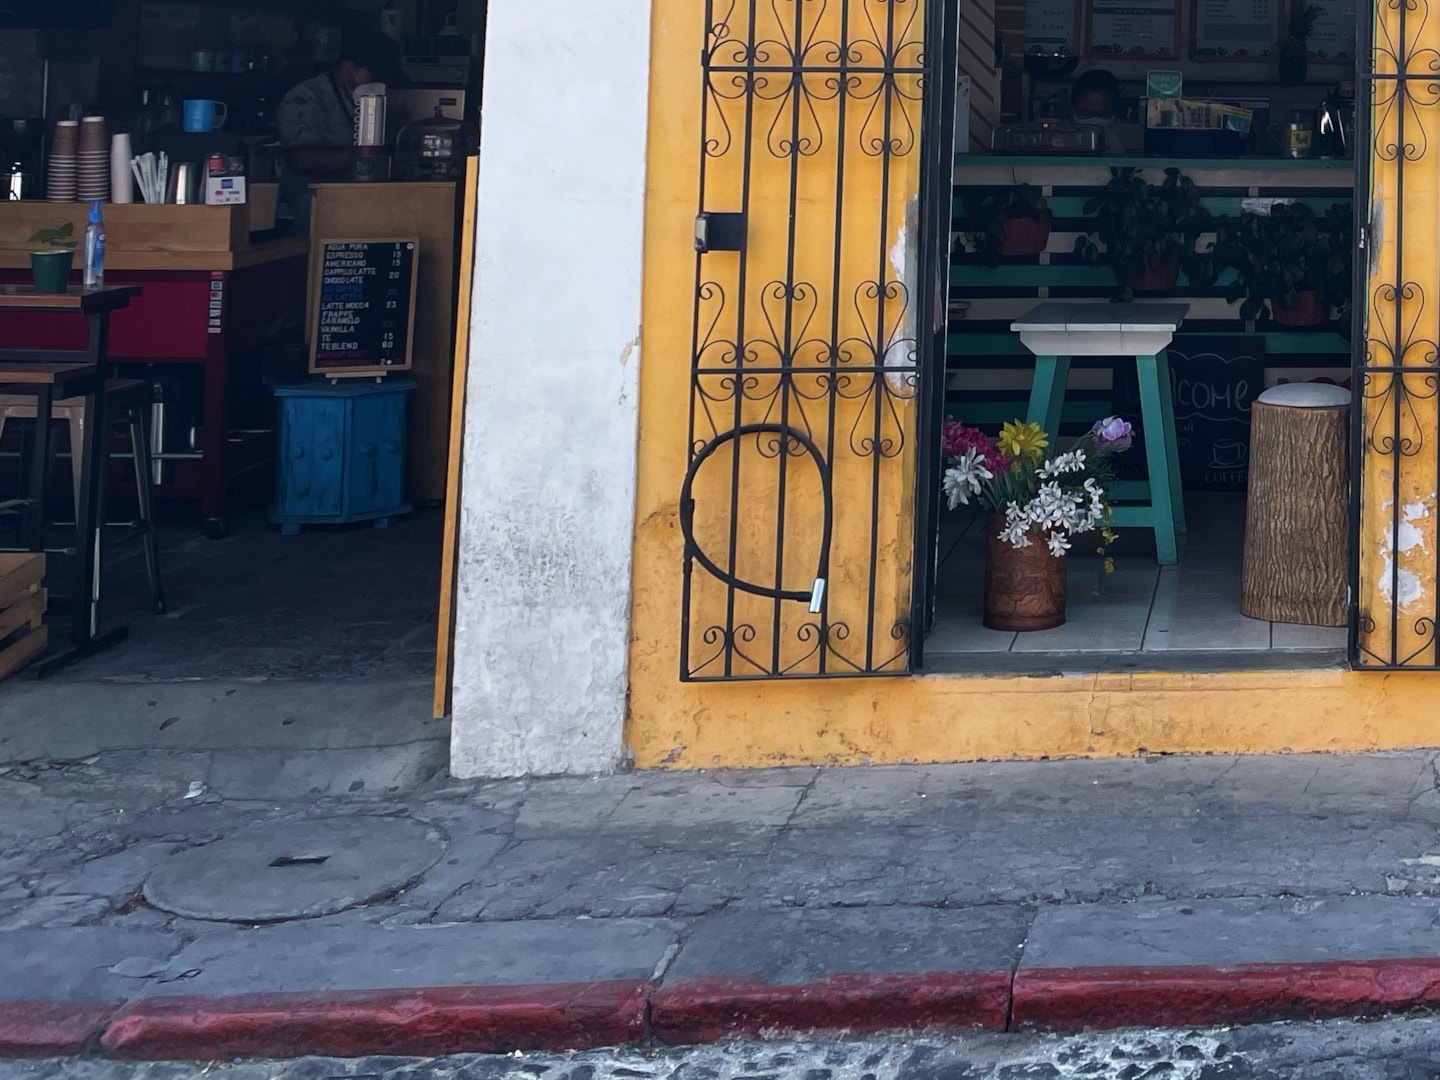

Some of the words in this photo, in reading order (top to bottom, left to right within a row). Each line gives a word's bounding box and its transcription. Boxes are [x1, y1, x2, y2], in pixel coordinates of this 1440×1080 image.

[326, 251, 364, 260] ESPRESSO
[392, 251, 402, 259] 15
[325, 259, 367, 268] AMERICANO
[391, 259, 401, 267] 15
[388, 271, 400, 280] 20
[383, 332, 394, 341] 15
